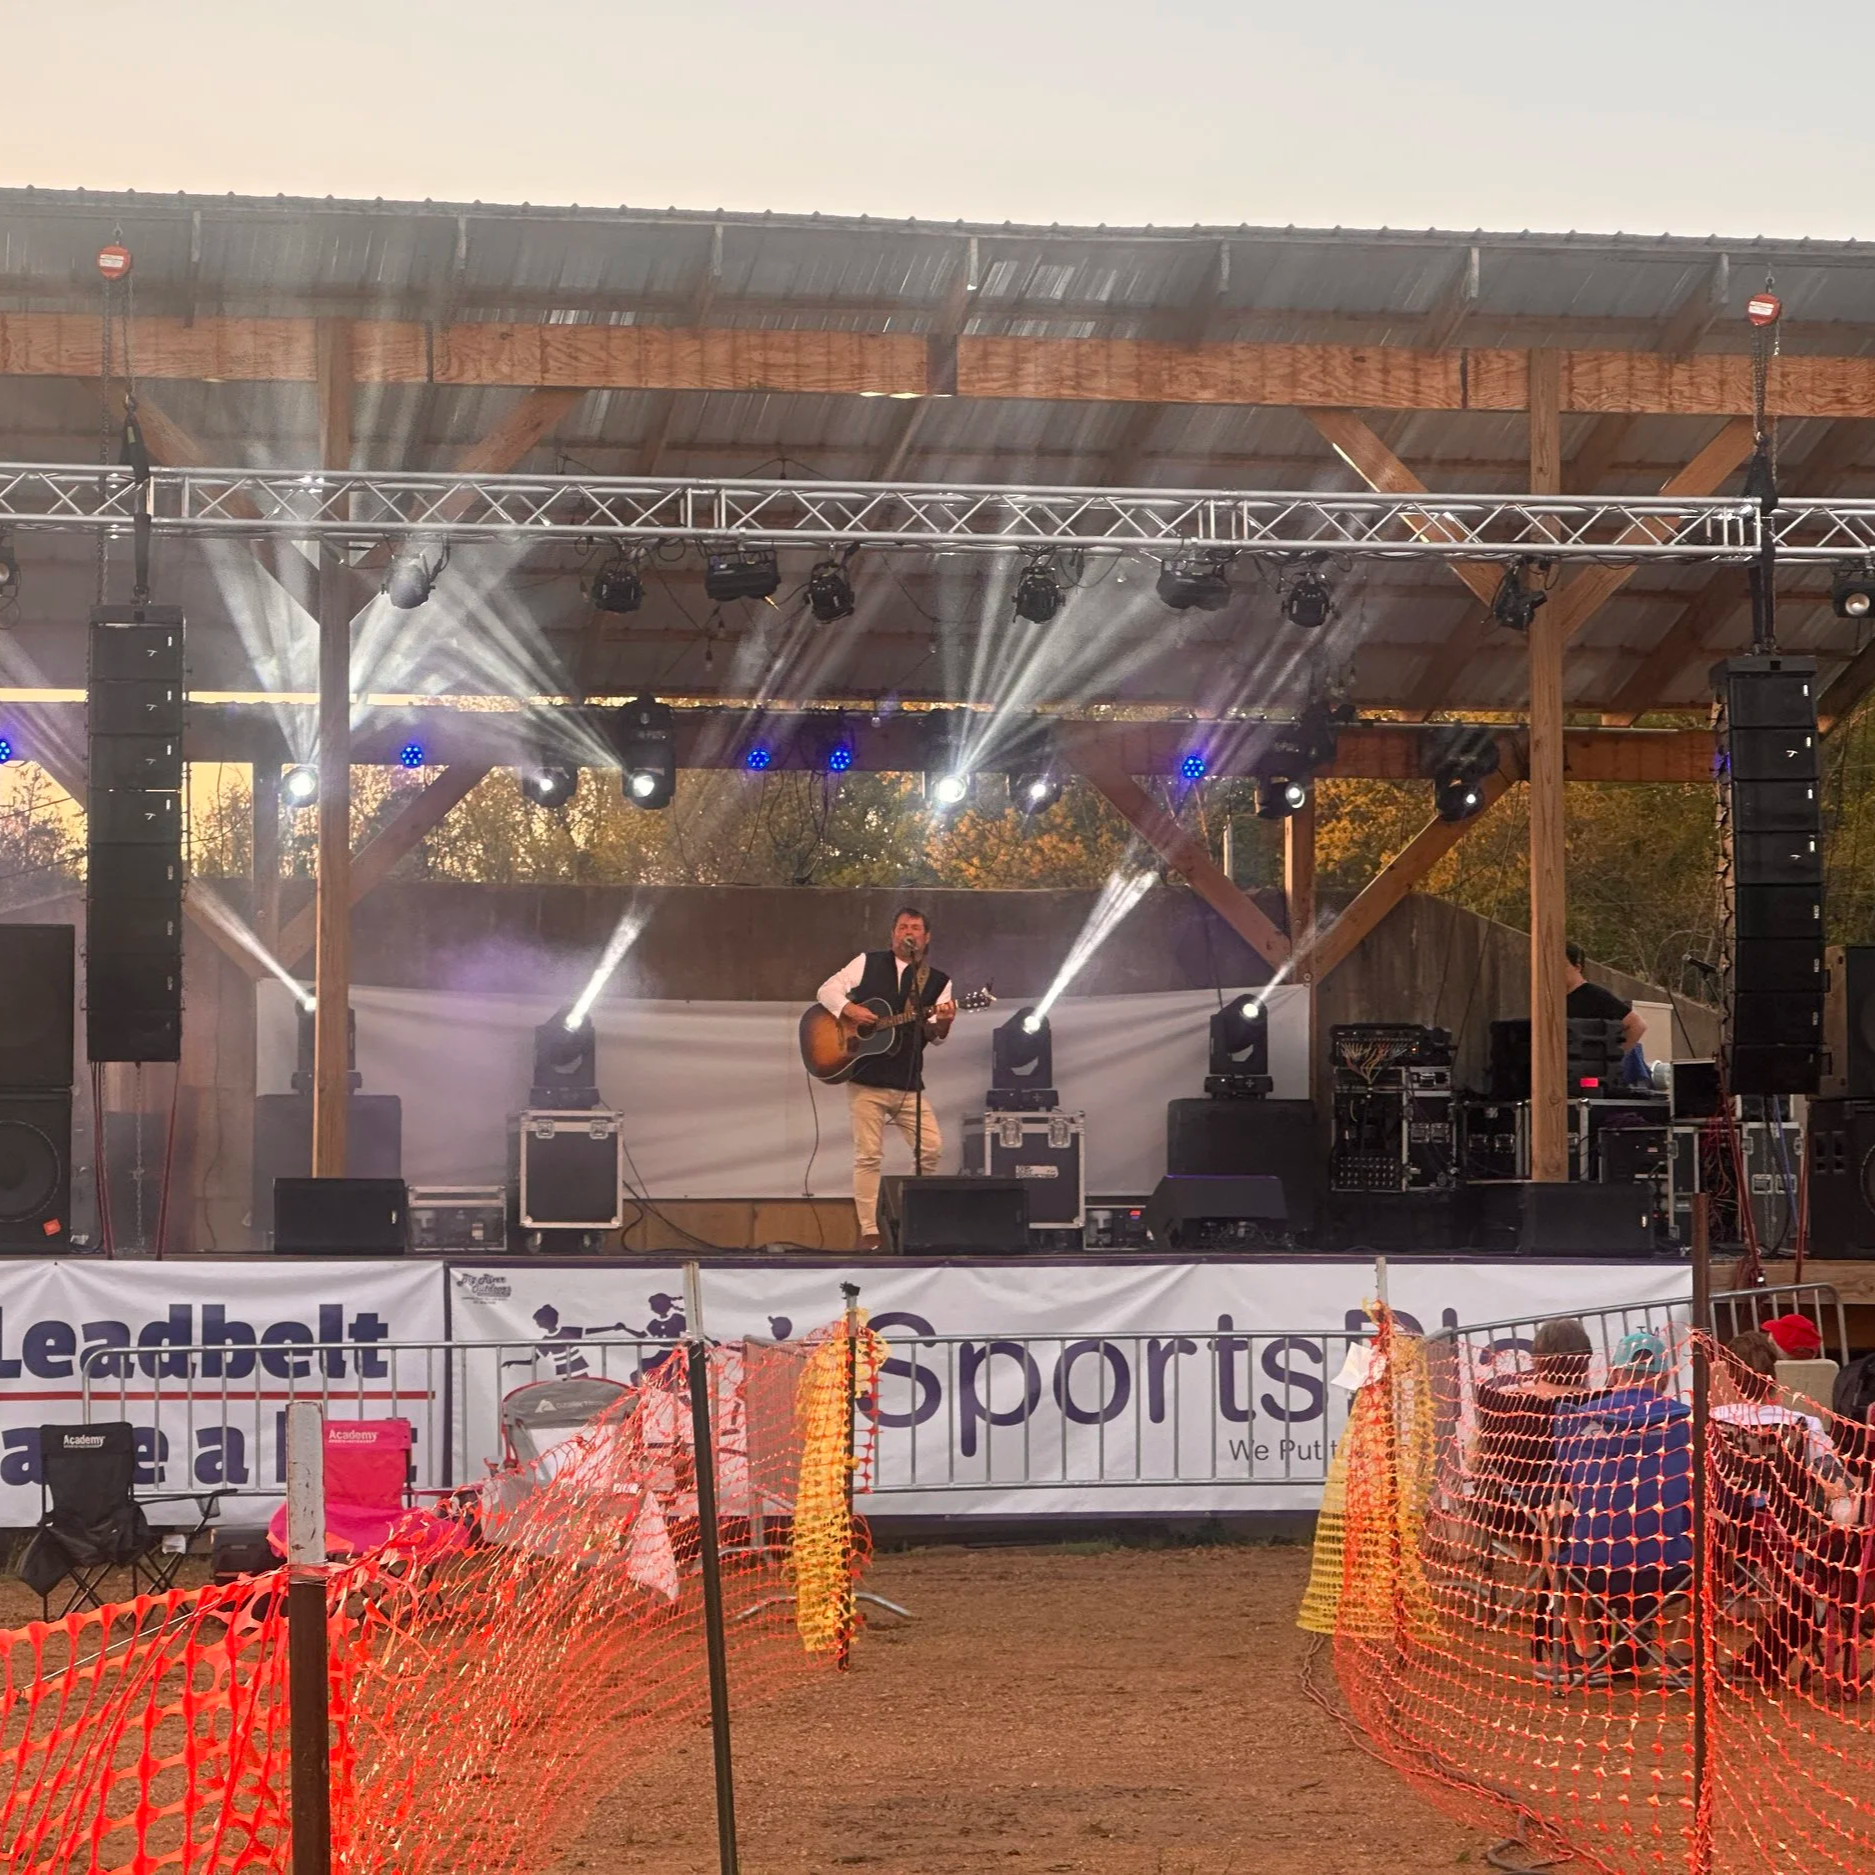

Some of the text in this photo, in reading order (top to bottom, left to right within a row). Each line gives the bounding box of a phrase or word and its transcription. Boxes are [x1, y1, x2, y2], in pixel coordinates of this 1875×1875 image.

[63, 1434, 106, 1447] Academy
[329, 1429, 379, 1442] Academy
[1229, 1439, 1269, 1461] We
[1280, 1439, 1322, 1461] Put
